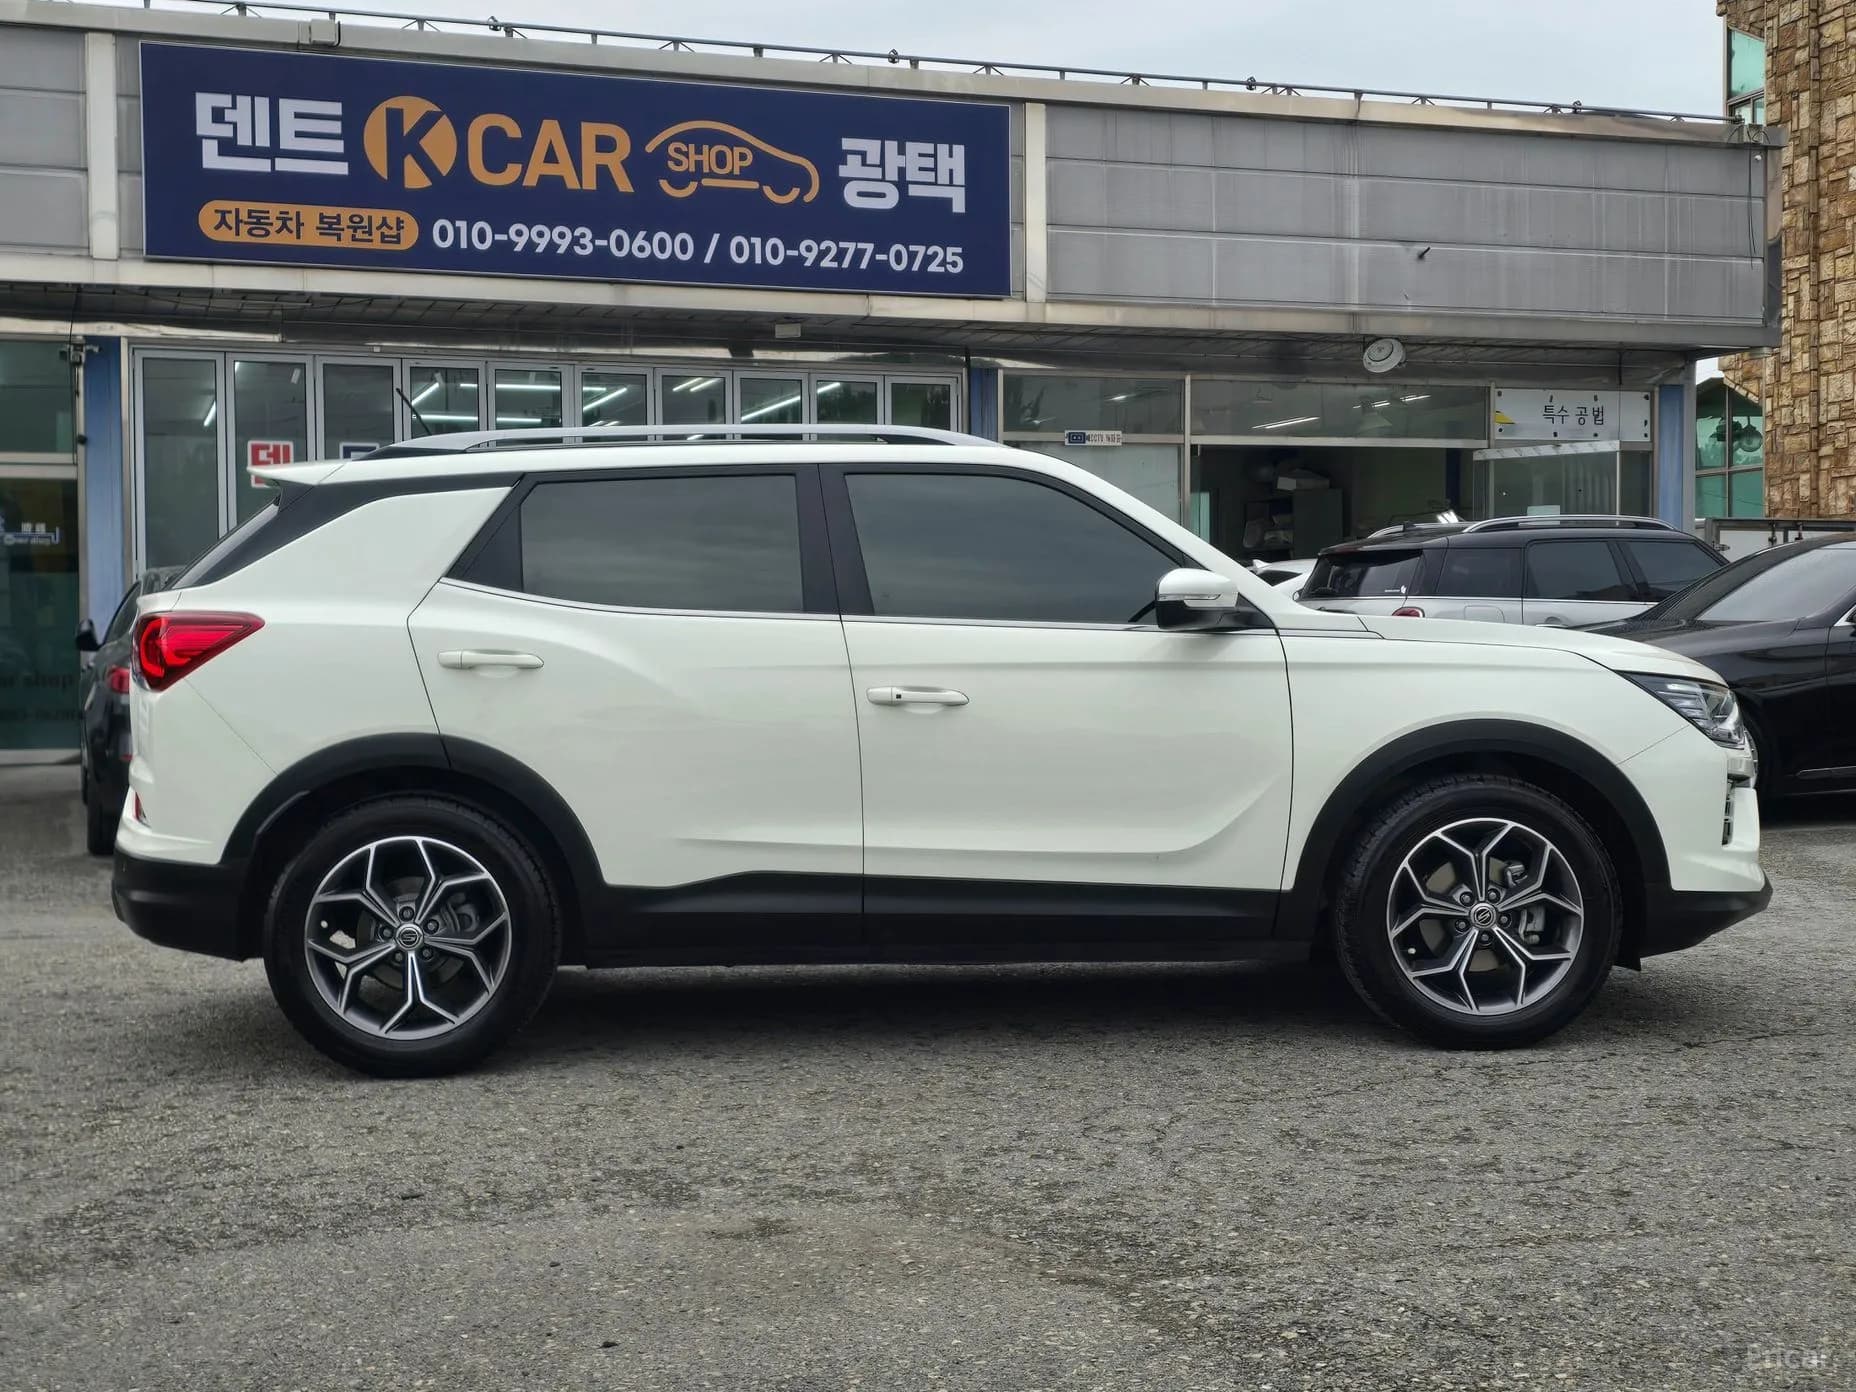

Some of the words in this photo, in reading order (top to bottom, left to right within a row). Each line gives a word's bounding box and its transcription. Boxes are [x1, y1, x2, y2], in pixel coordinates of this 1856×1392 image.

[195, 92, 349, 175] 덴트
[383, 100, 448, 189] K
[467, 113, 635, 193] CAR
[667, 141, 753, 176] SHOP
[838, 137, 966, 213] 광택
[213, 207, 305, 240] 자동차
[315, 211, 405, 245] 복원샵
[432, 218, 694, 261] 010-9993-0600
[729, 235, 964, 274] 010-9277-0725
[1542, 404, 1570, 425] 특수
[1574, 404, 1605, 426] 공법
